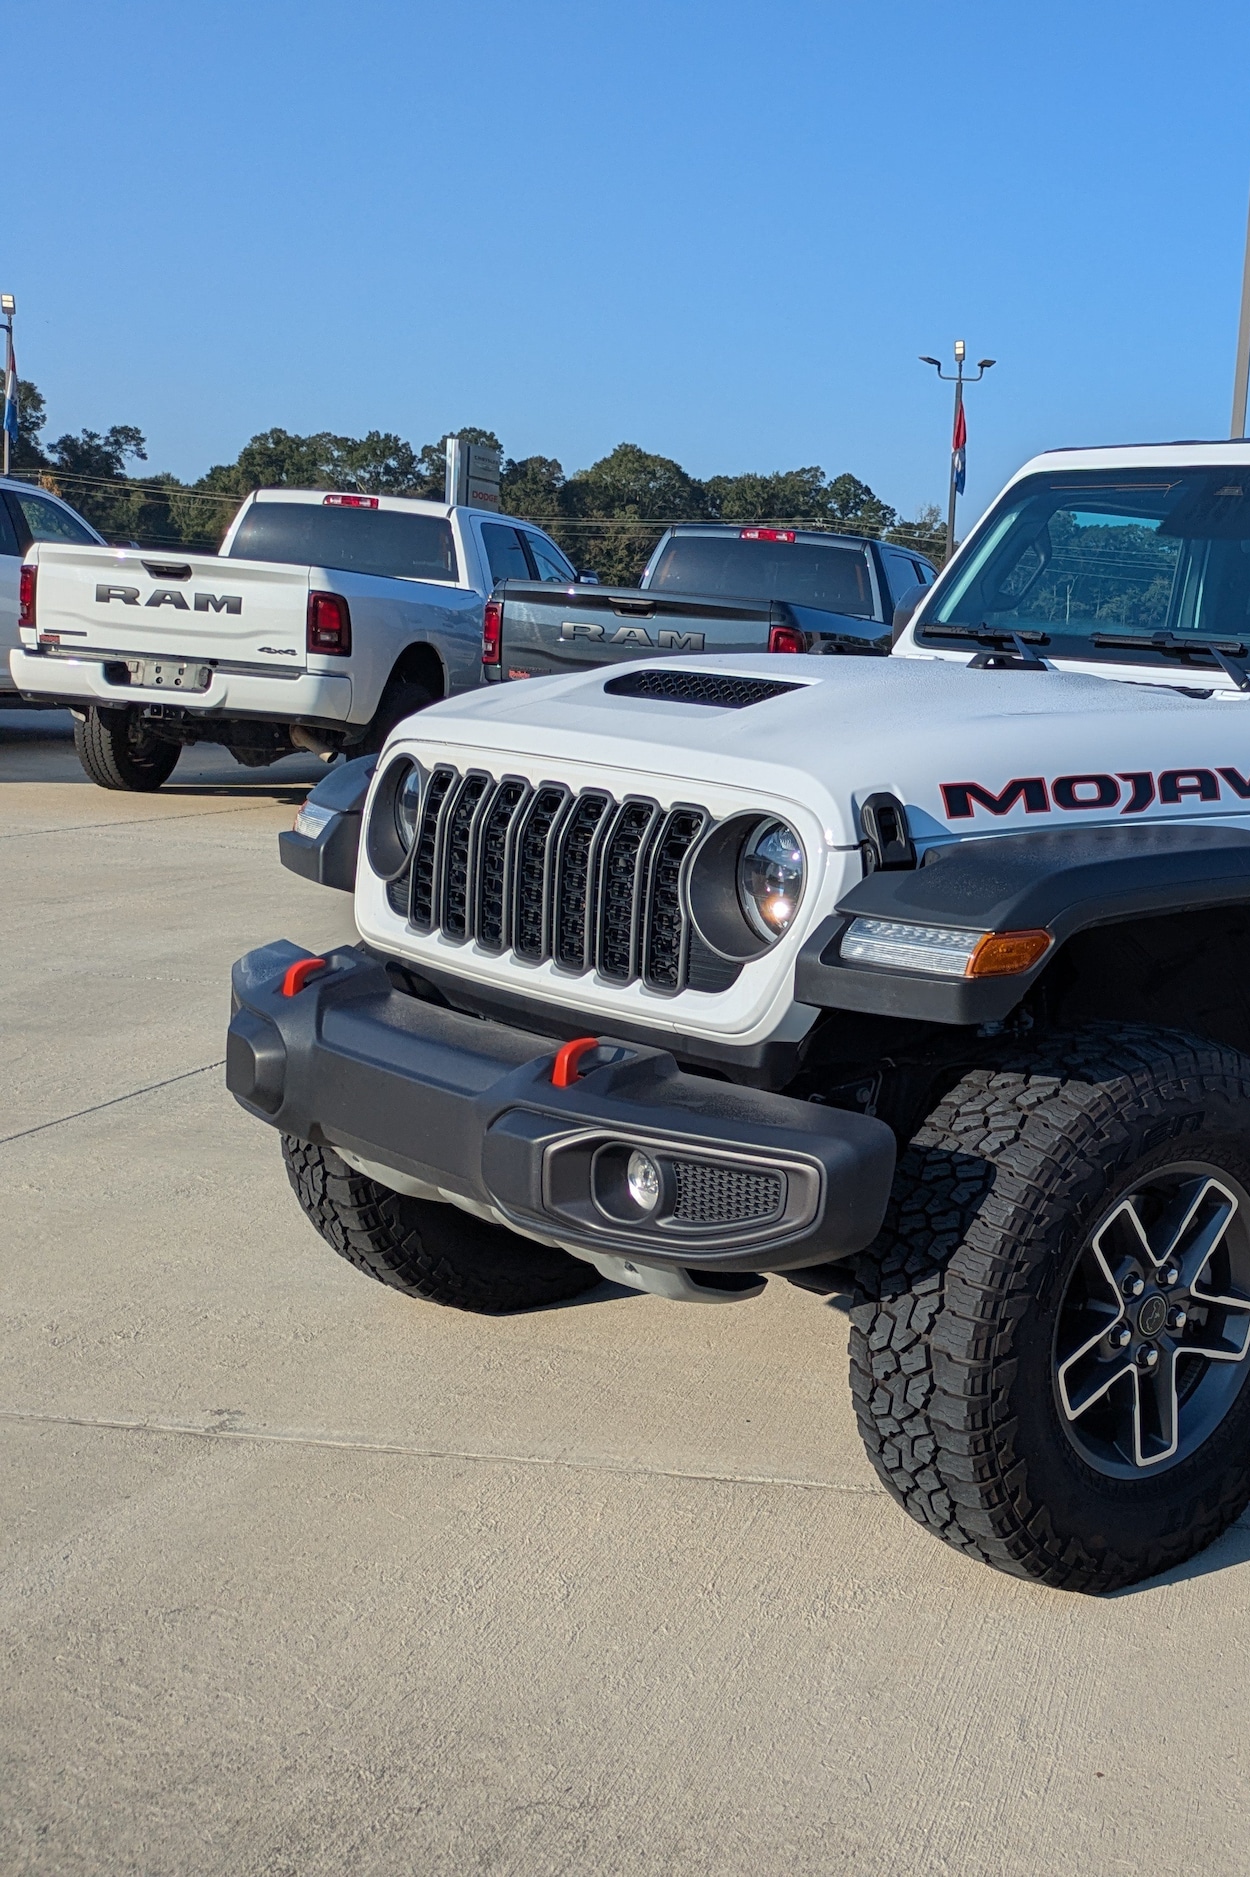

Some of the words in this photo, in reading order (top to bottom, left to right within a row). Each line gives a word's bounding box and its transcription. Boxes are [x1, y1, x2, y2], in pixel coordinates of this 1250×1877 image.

[472, 490, 498, 503] DODGE
[95, 584, 242, 615] RAM
[561, 621, 705, 650] RAM
